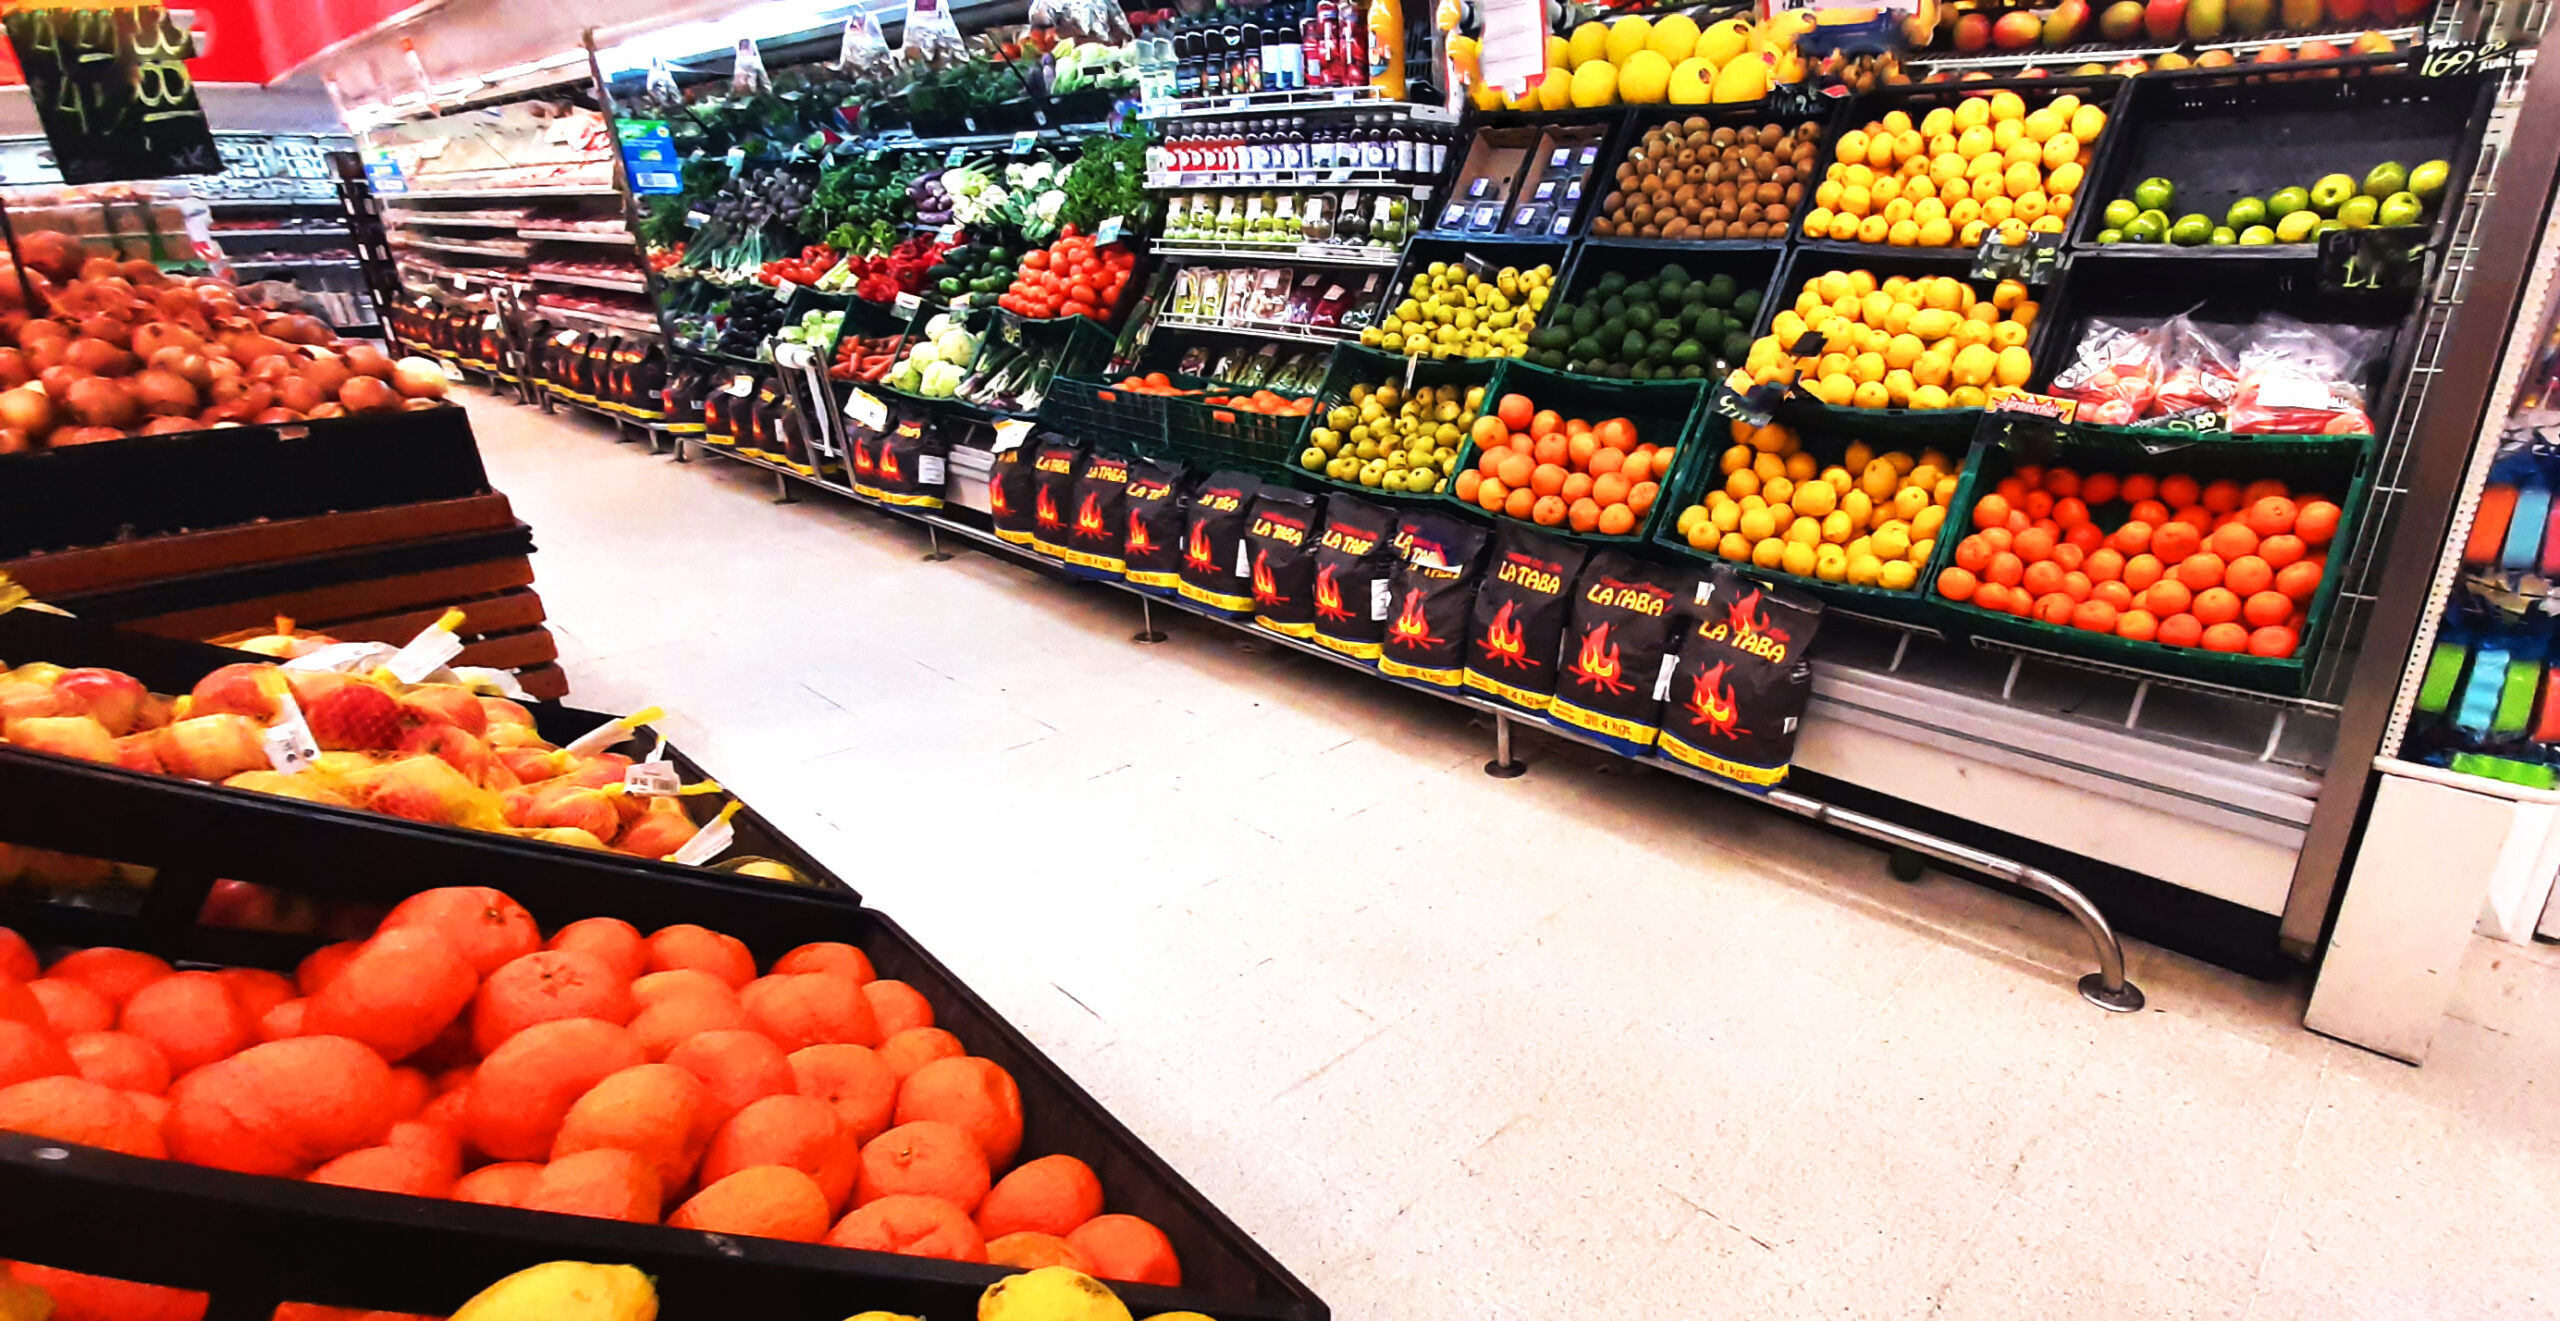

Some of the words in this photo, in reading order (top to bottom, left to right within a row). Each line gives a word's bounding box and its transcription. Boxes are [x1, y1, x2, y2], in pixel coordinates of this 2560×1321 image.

[1252, 518, 1272, 537] LA
[1321, 529, 1342, 550] LA
[1498, 560, 1517, 583] LA
[1516, 565, 1561, 595] TABA
[1587, 583, 1615, 606] LA
[1613, 588, 1665, 617] TABA
[1698, 620, 1729, 642] LA
[1731, 630, 1786, 664] TABA
[1601, 719, 1608, 730] 4
[1717, 762, 1725, 772] 4
